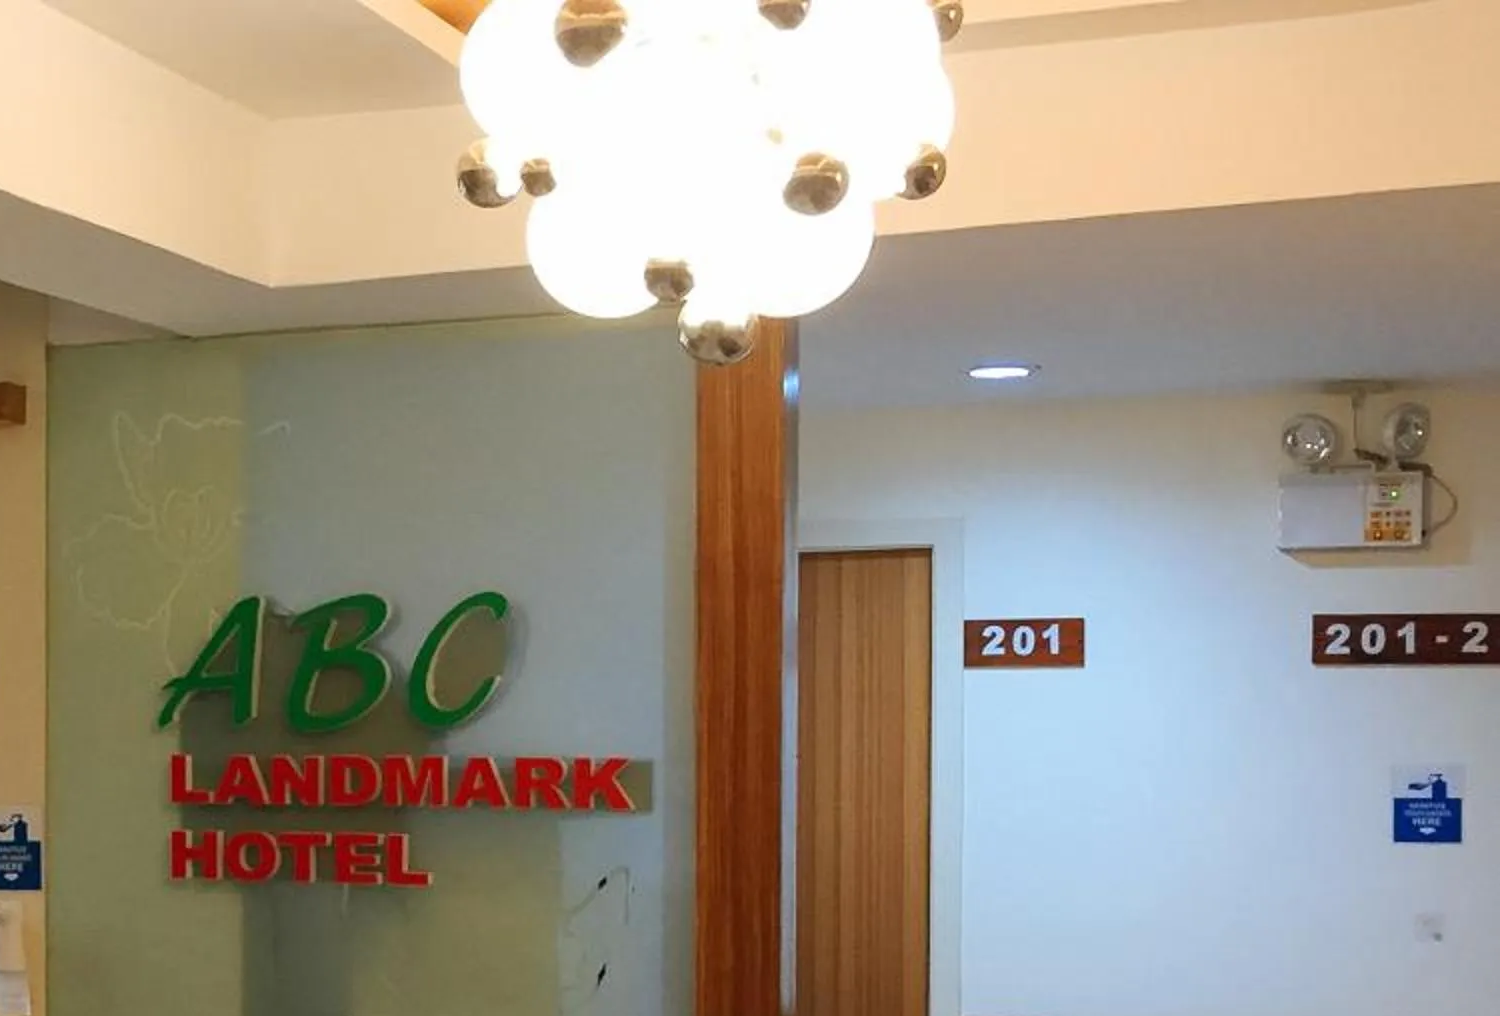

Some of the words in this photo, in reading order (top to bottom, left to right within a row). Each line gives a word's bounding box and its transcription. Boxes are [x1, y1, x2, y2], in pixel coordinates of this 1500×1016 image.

[158, 591, 510, 733] ABC
[980, 624, 1061, 656] 201
[168, 752, 636, 814] LANDMARK
[168, 829, 434, 888] HOTEL
